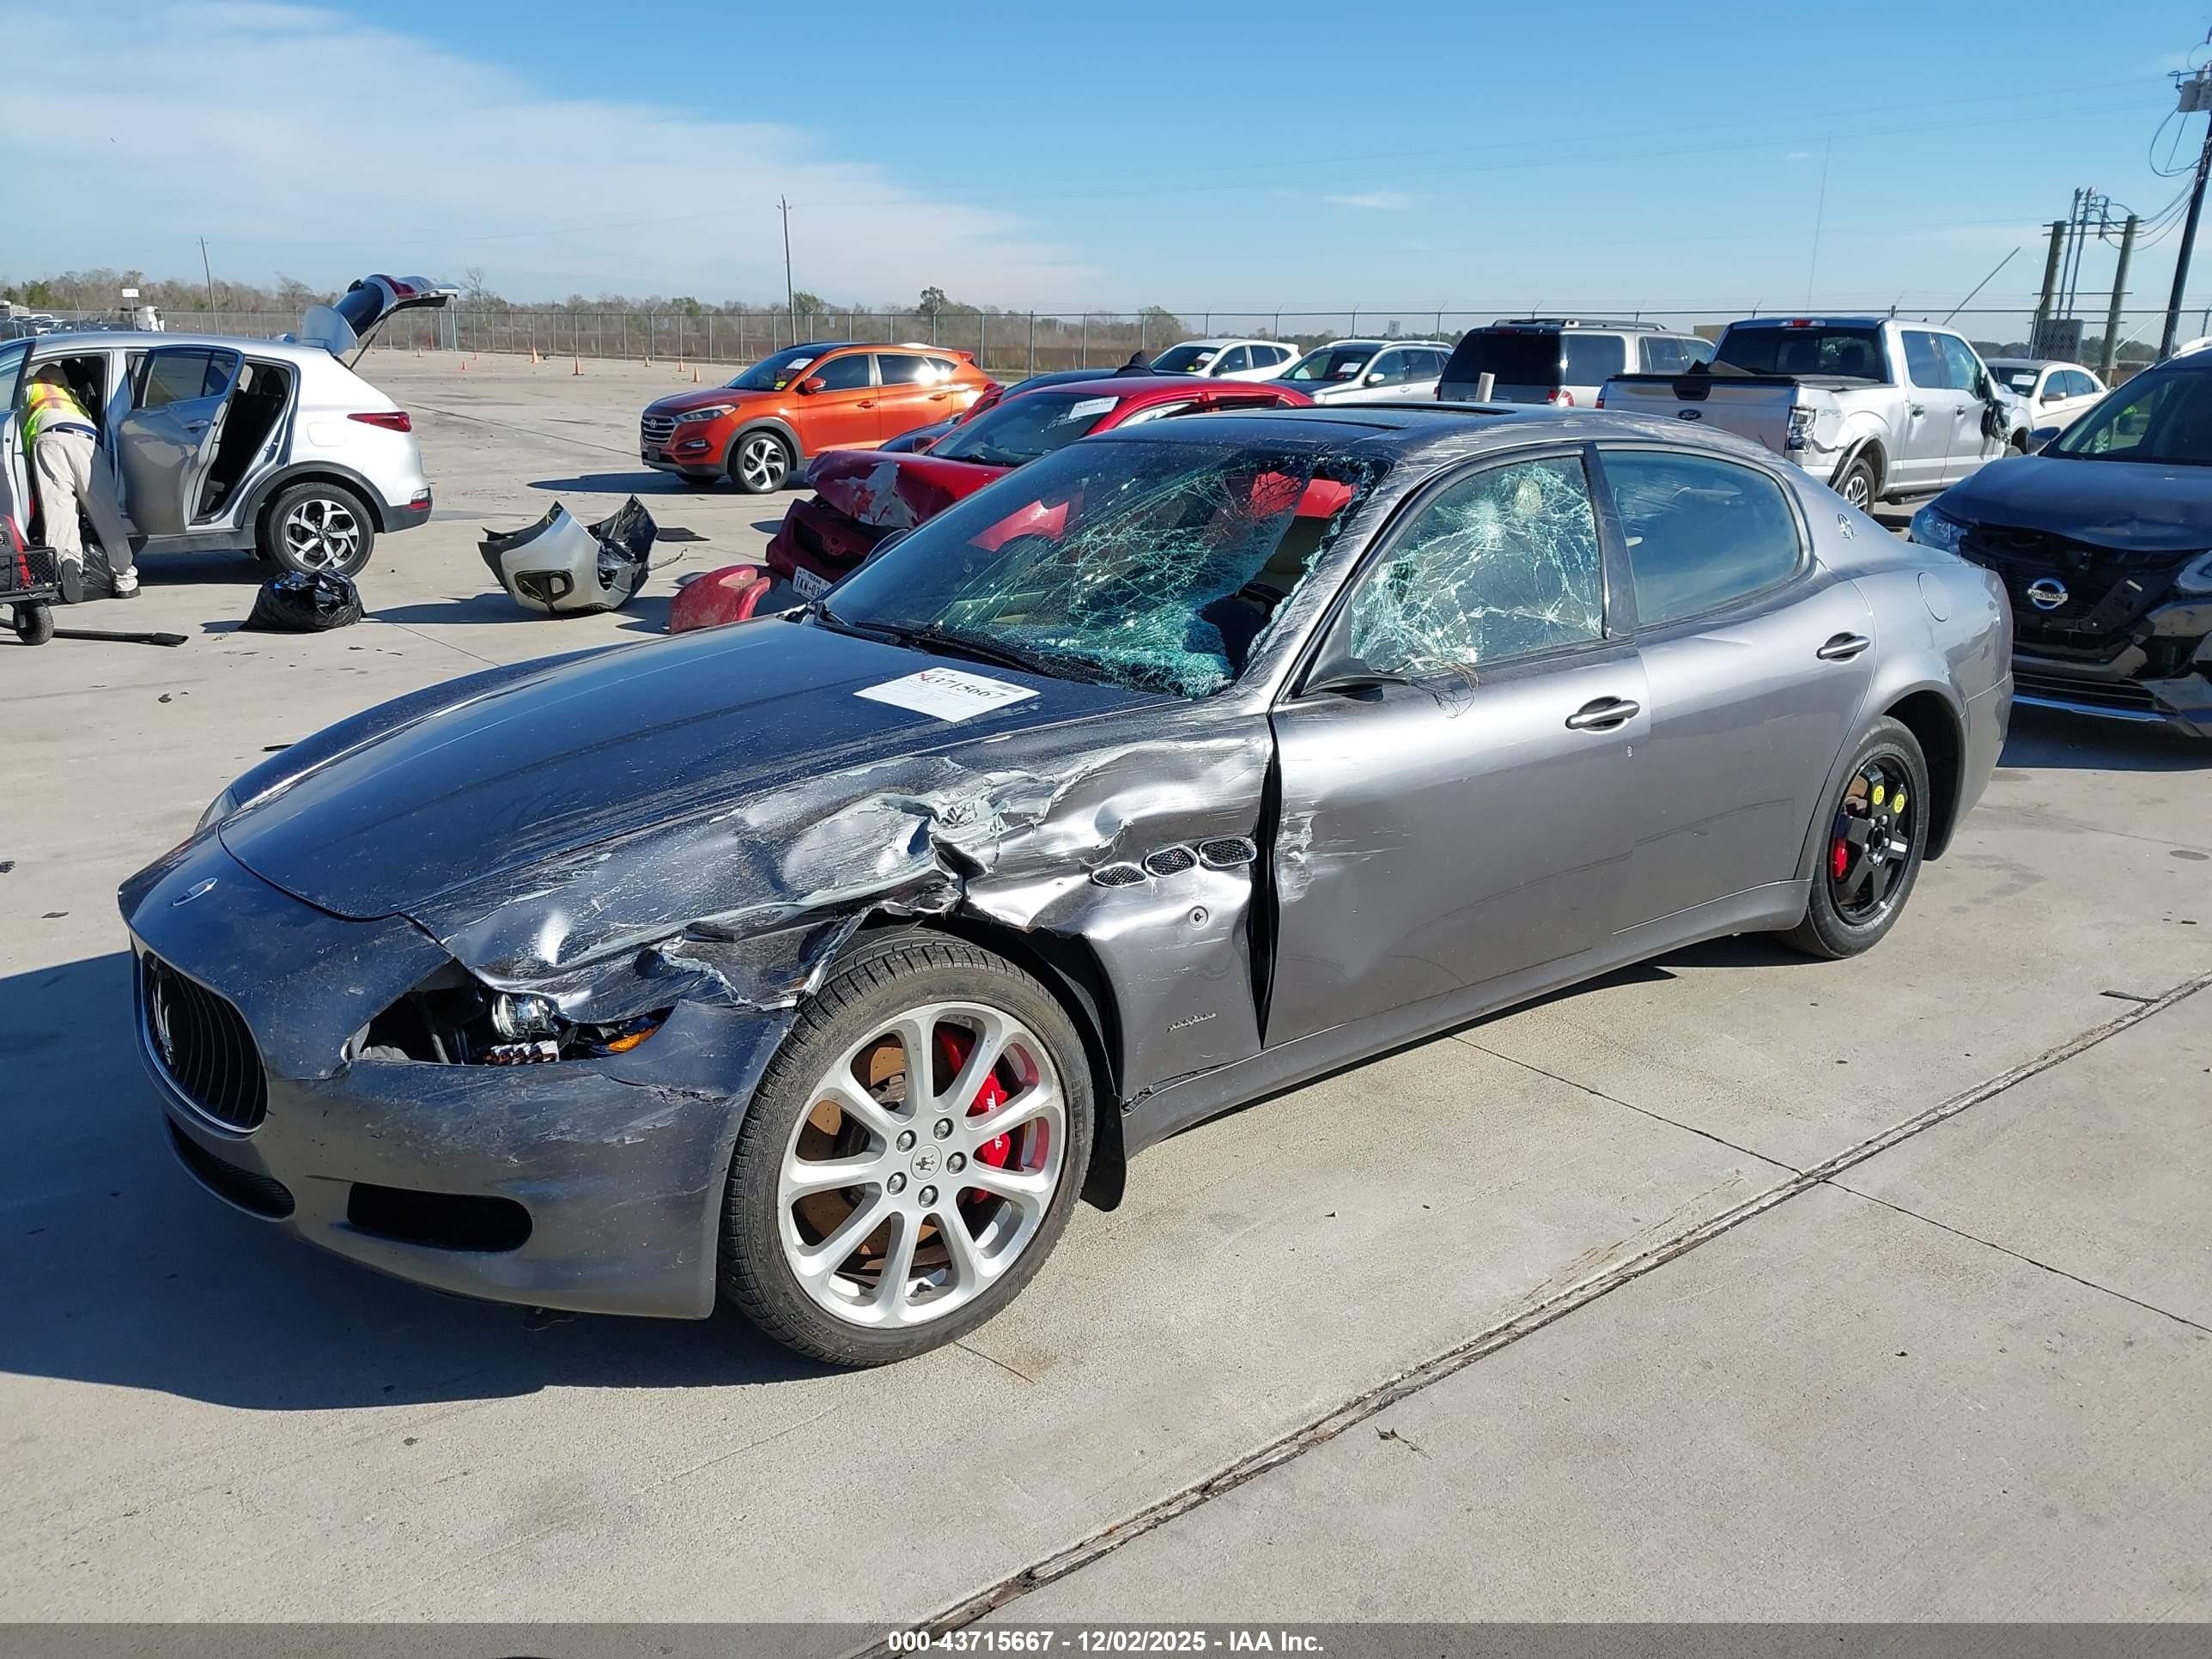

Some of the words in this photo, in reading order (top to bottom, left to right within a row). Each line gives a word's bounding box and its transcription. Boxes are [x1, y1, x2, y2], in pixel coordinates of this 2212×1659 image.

[807, 573, 822, 585] TEXAS
[2031, 590, 2063, 600] NISSAN
[921, 675, 1008, 700] 43715667
